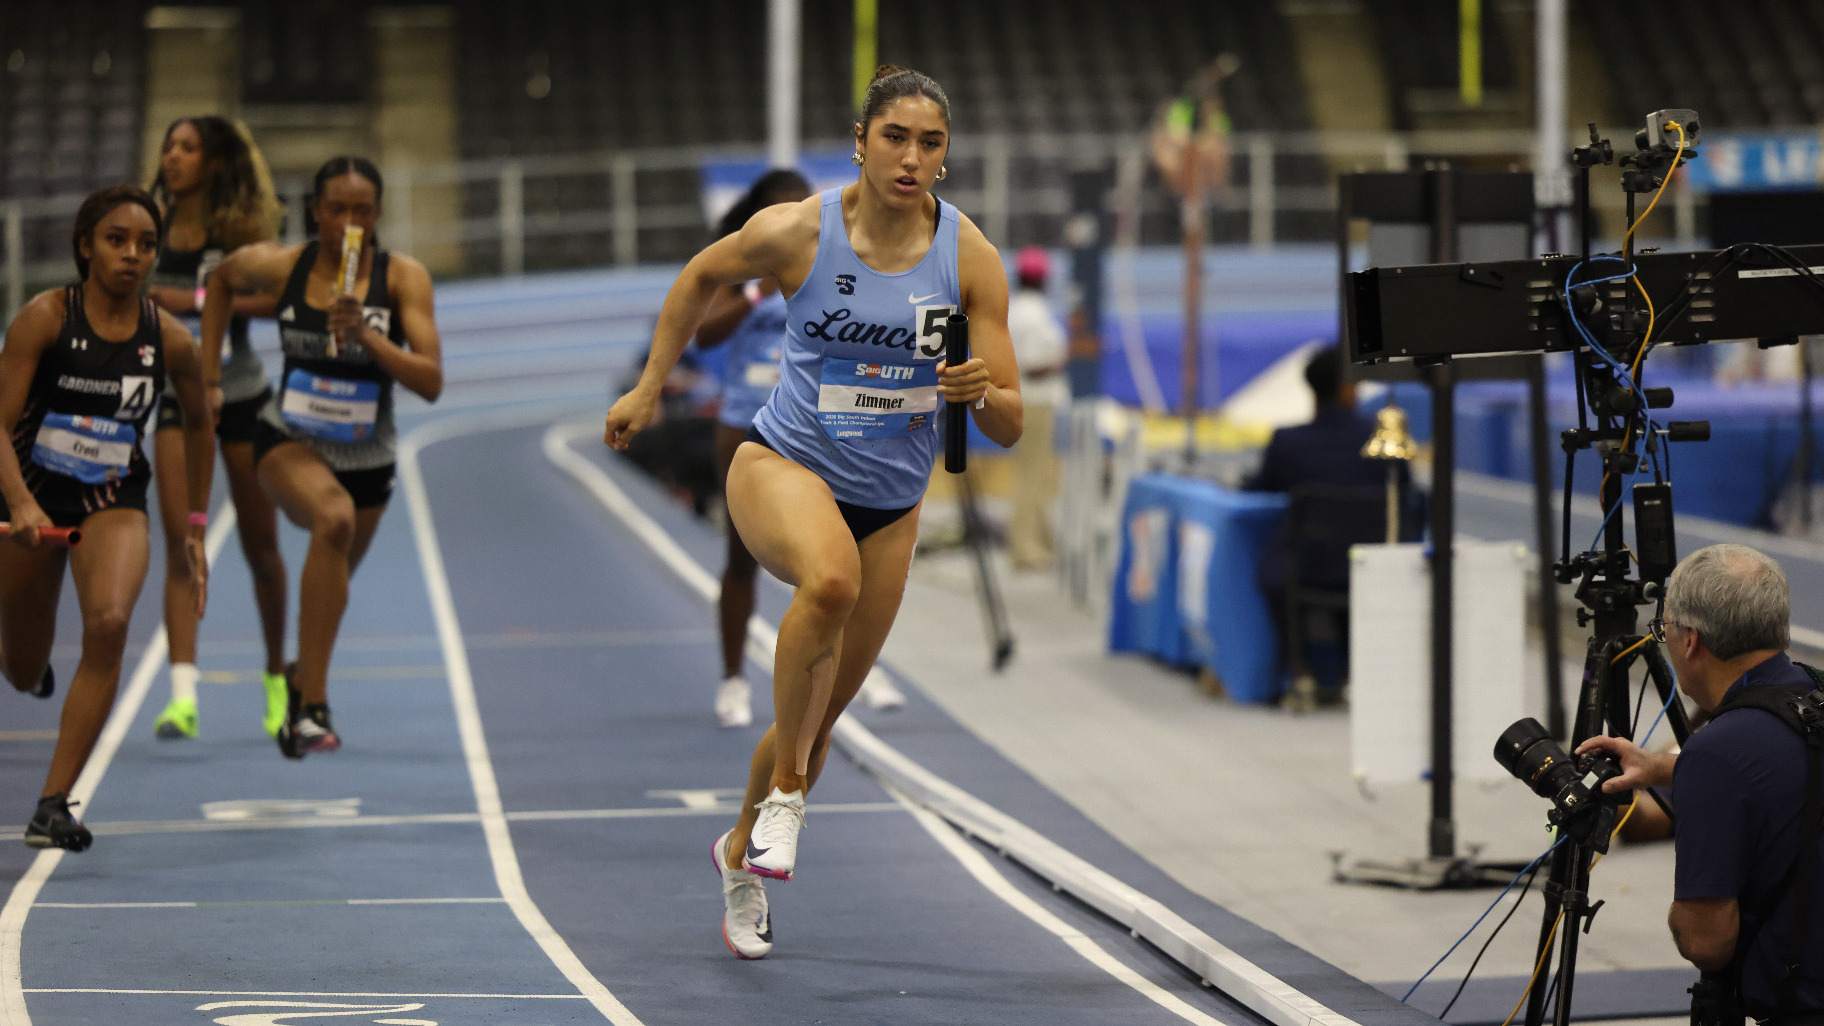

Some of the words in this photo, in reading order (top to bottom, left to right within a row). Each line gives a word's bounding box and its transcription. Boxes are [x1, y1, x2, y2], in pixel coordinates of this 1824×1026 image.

[920, 308, 950, 358] 5
[123, 380, 148, 419] 4
[854, 393, 905, 410] Zimmer
